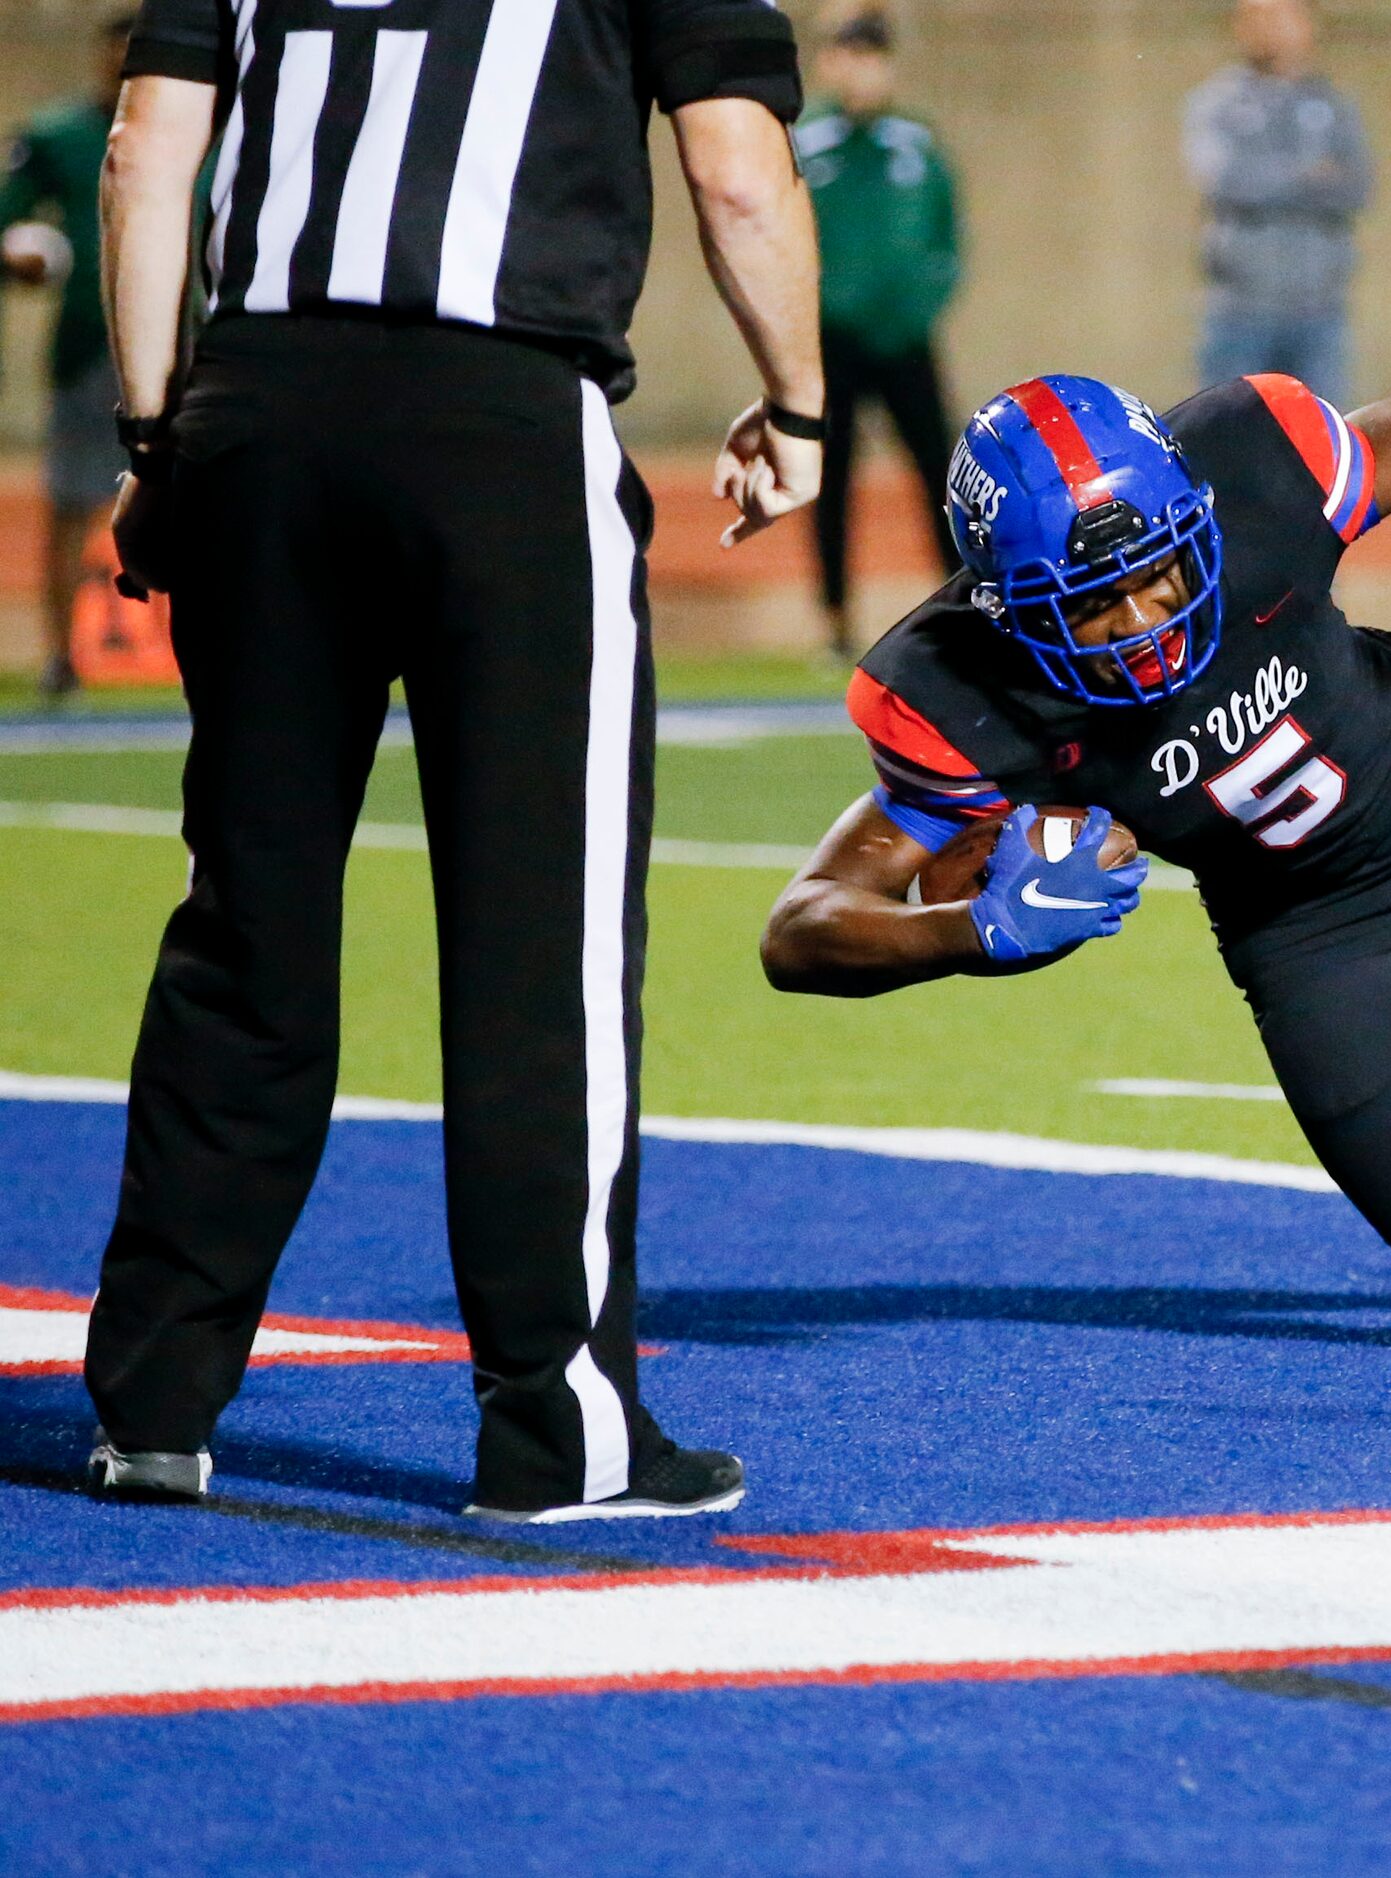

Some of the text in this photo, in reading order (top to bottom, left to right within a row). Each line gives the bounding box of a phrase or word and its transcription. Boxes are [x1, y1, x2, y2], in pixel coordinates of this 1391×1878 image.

[948, 437, 1008, 521] NTHERS
[1150, 655, 1308, 797] D'Ville
[1203, 713, 1348, 848] 5
